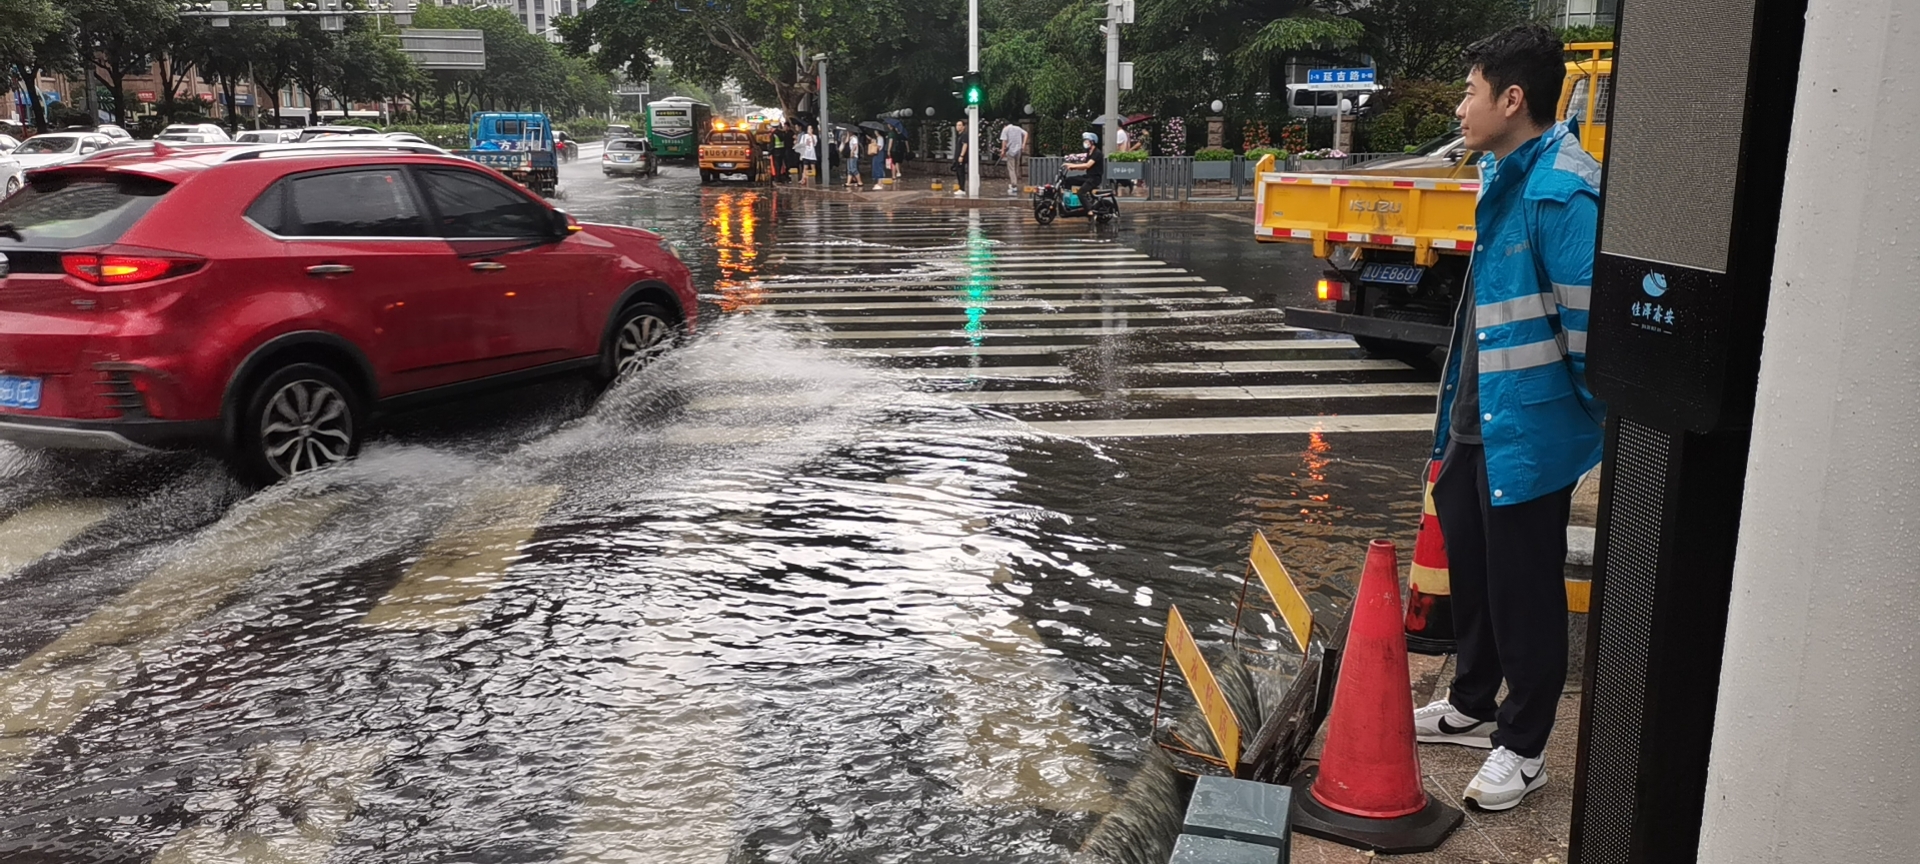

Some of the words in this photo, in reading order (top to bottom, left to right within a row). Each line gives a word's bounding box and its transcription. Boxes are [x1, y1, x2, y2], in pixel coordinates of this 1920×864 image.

[1323, 71, 1360, 82] 延吉路
[1349, 199, 1402, 213] ISUZU
